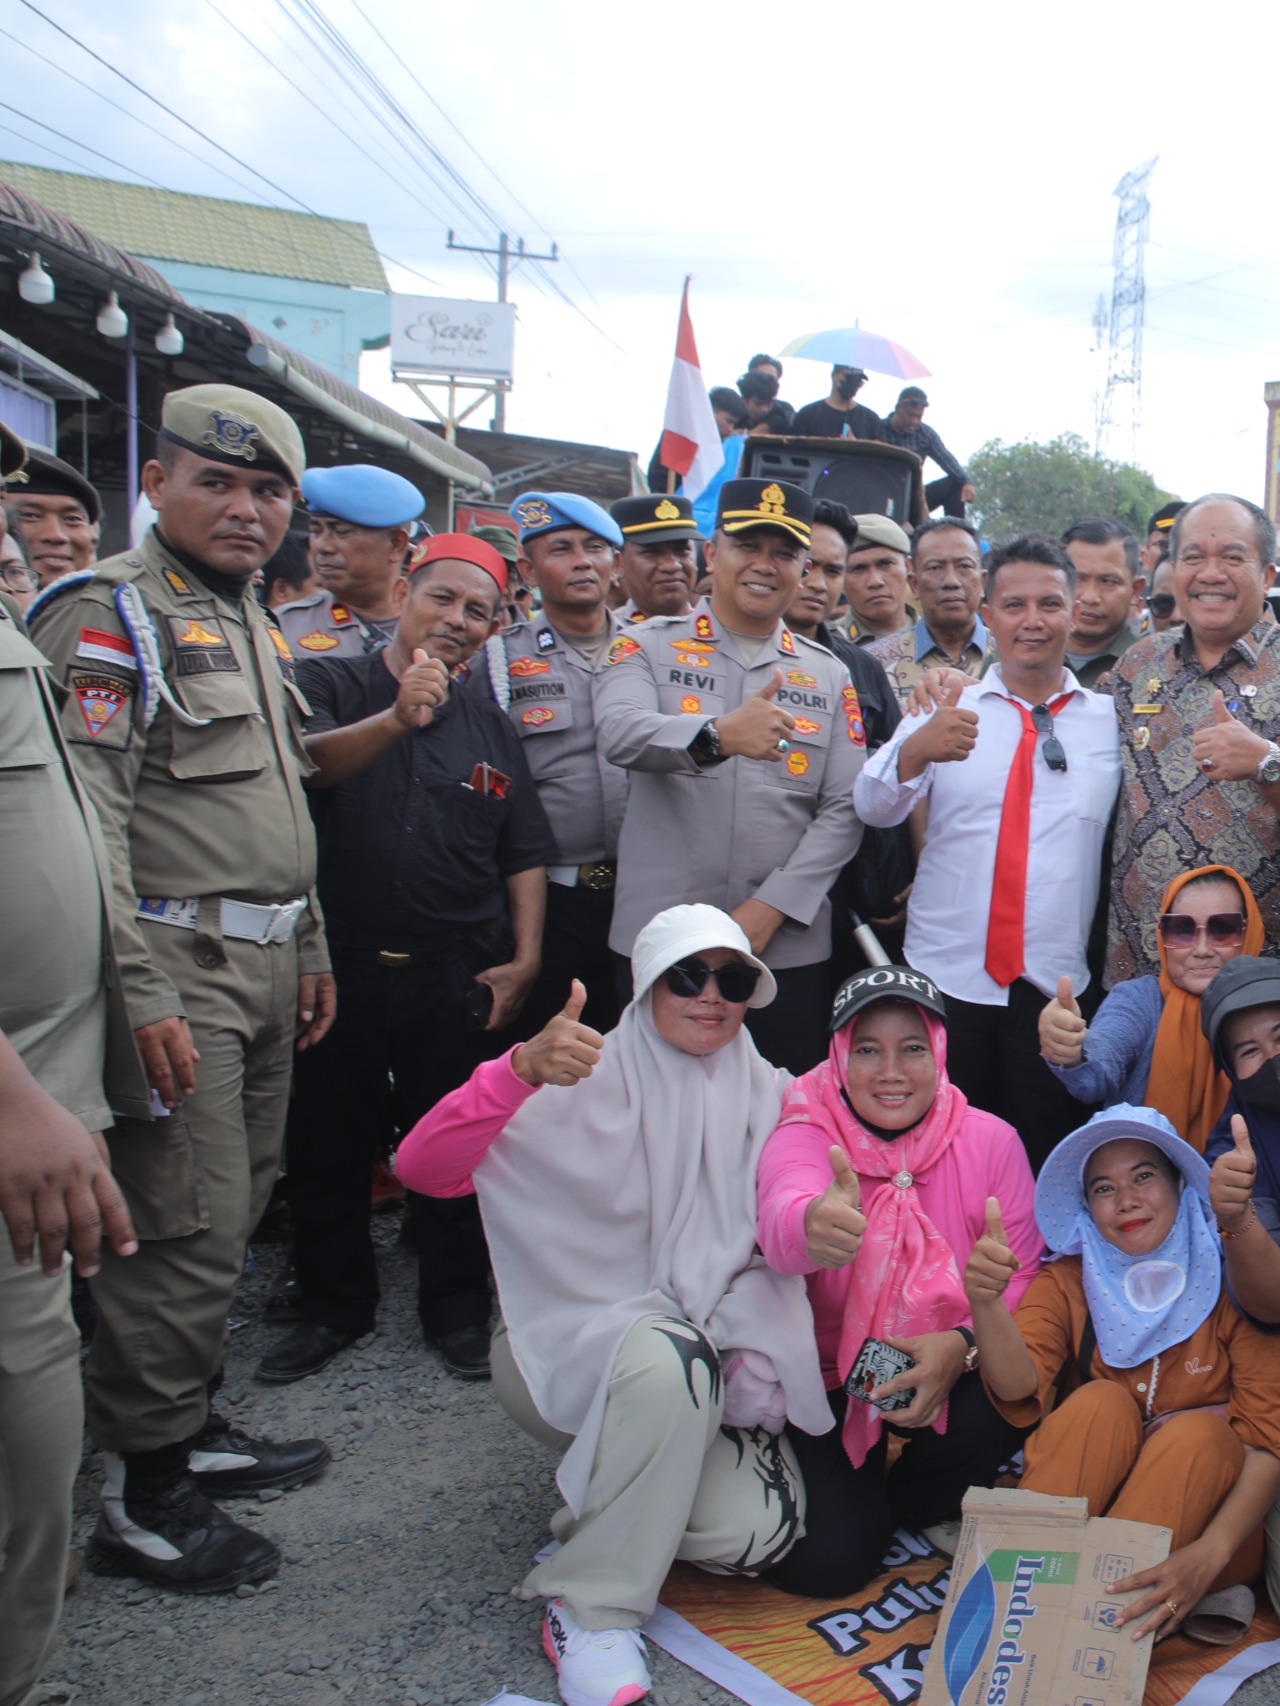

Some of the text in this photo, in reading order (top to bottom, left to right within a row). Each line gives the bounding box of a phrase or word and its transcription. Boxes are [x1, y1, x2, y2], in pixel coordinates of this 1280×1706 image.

[669, 669, 715, 692] REVI
[86, 689, 117, 700] PTI
[777, 690, 828, 710] POLRI
[833, 970, 939, 1016] SPORT
[987, 1555, 1045, 1706] Indodes
[1025, 1668, 1035, 1686] Untuk
[975, 1680, 986, 1705] Mineral
